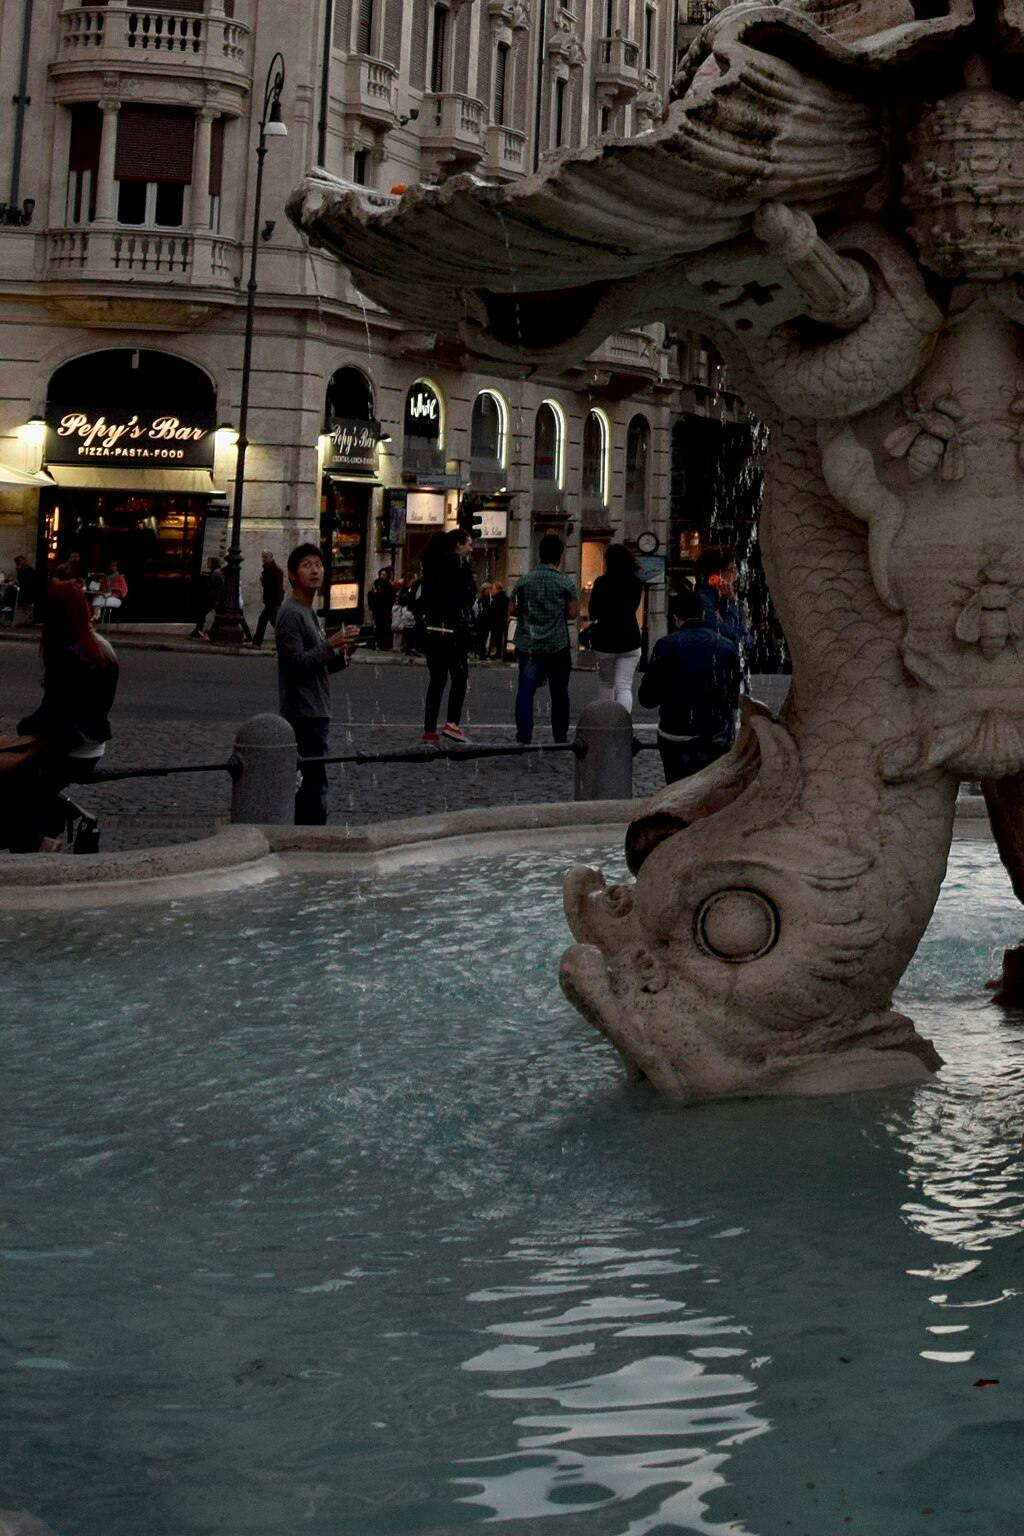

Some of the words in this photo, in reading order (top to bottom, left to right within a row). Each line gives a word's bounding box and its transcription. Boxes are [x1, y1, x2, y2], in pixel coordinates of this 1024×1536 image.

[57, 413, 147, 448] Pepy's
[148, 416, 208, 441] Bar
[331, 424, 358, 455] Pepy's
